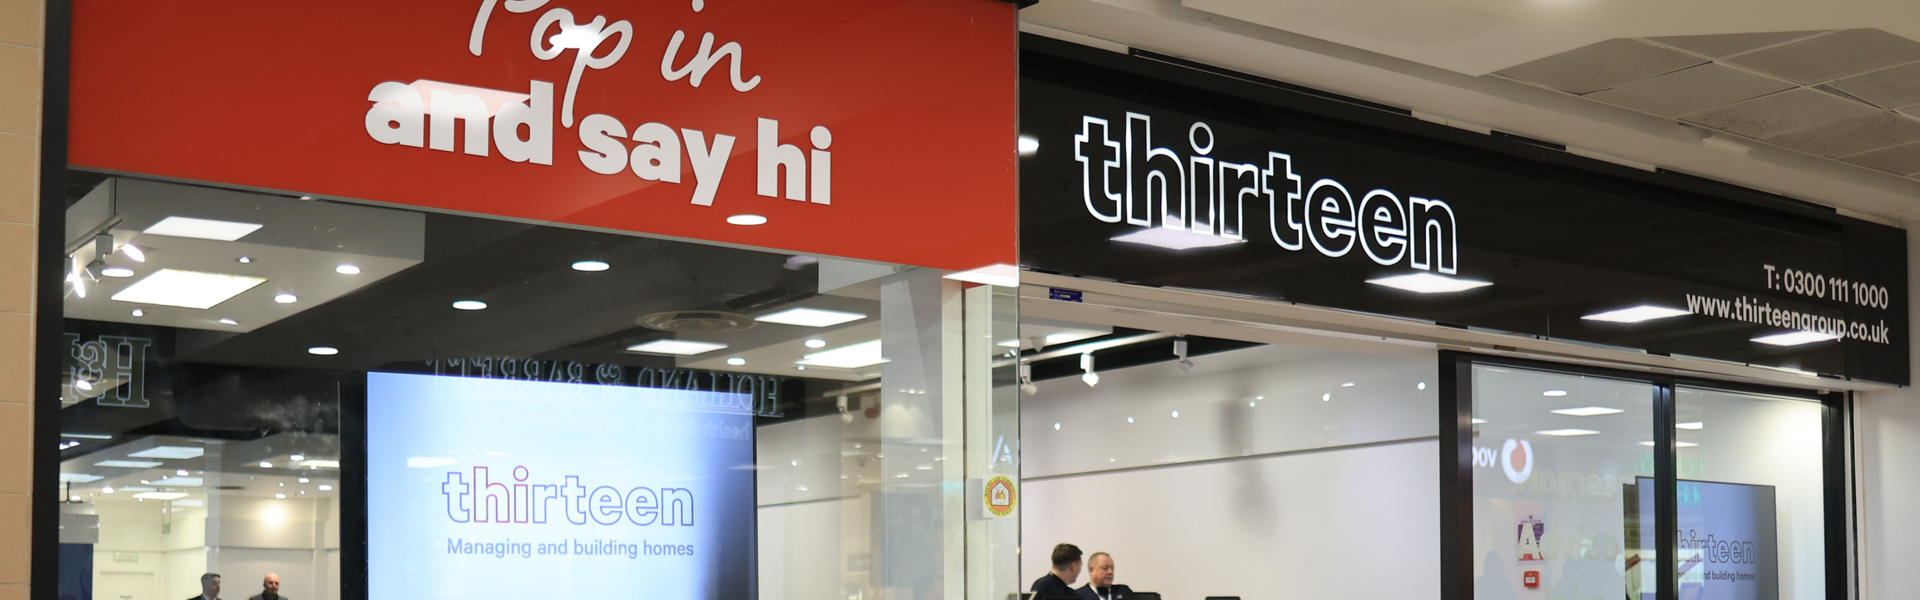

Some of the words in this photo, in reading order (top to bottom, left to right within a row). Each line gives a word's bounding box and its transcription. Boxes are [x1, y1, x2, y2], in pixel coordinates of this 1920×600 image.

[661, 0, 761, 92] in
[365, 79, 554, 166] and
[577, 113, 736, 207] say
[757, 117, 832, 205] hi
[1074, 111, 1458, 275] thirteen
[1763, 264, 1780, 291] T:
[1783, 268, 1826, 299] 0300
[1828, 277, 1849, 303] 111
[1852, 281, 1889, 310] 1000
[1686, 293, 1890, 345] www.thirteengroup.co.uk
[442, 465, 695, 527] thirteen
[447, 537, 532, 559] Managing
[537, 538, 569, 556] and
[573, 539, 638, 560] building
[643, 540, 695, 557] homes
[1677, 529, 1756, 565] hirteen
[1712, 571, 1736, 583] building
[1736, 571, 1756, 581] homes
